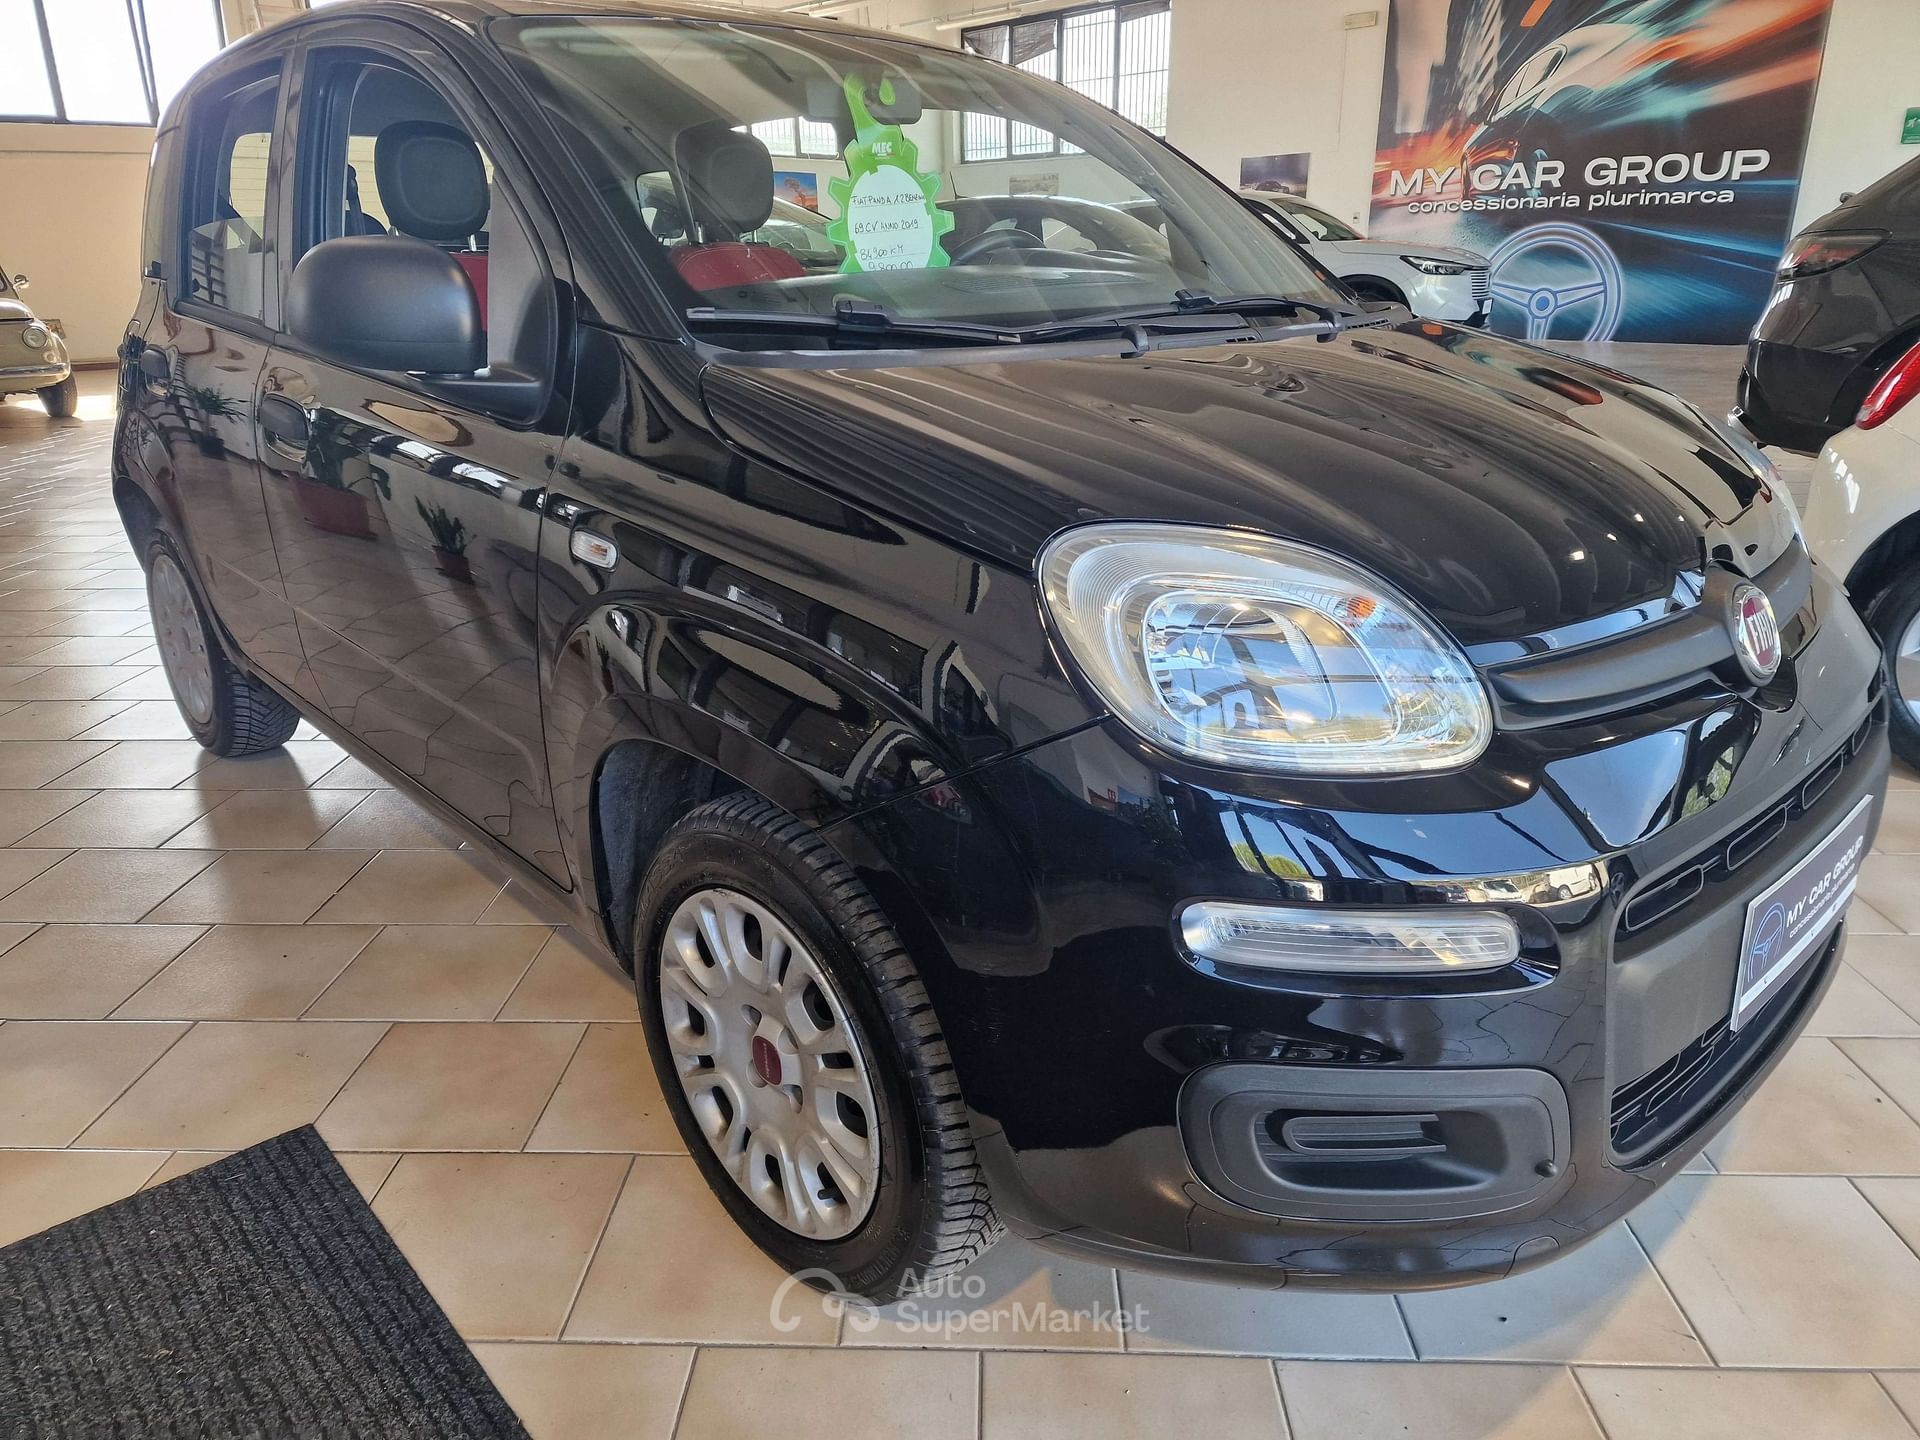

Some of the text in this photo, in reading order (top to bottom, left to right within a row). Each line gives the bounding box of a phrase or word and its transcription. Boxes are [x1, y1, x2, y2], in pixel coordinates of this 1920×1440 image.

[1389, 149, 1771, 196] MY CAR GROUP
[1408, 189, 1735, 214] concessionaria plurimarca
[900, 218, 918, 229] 2019
[1787, 835, 1863, 928] MY CAR GROUP
